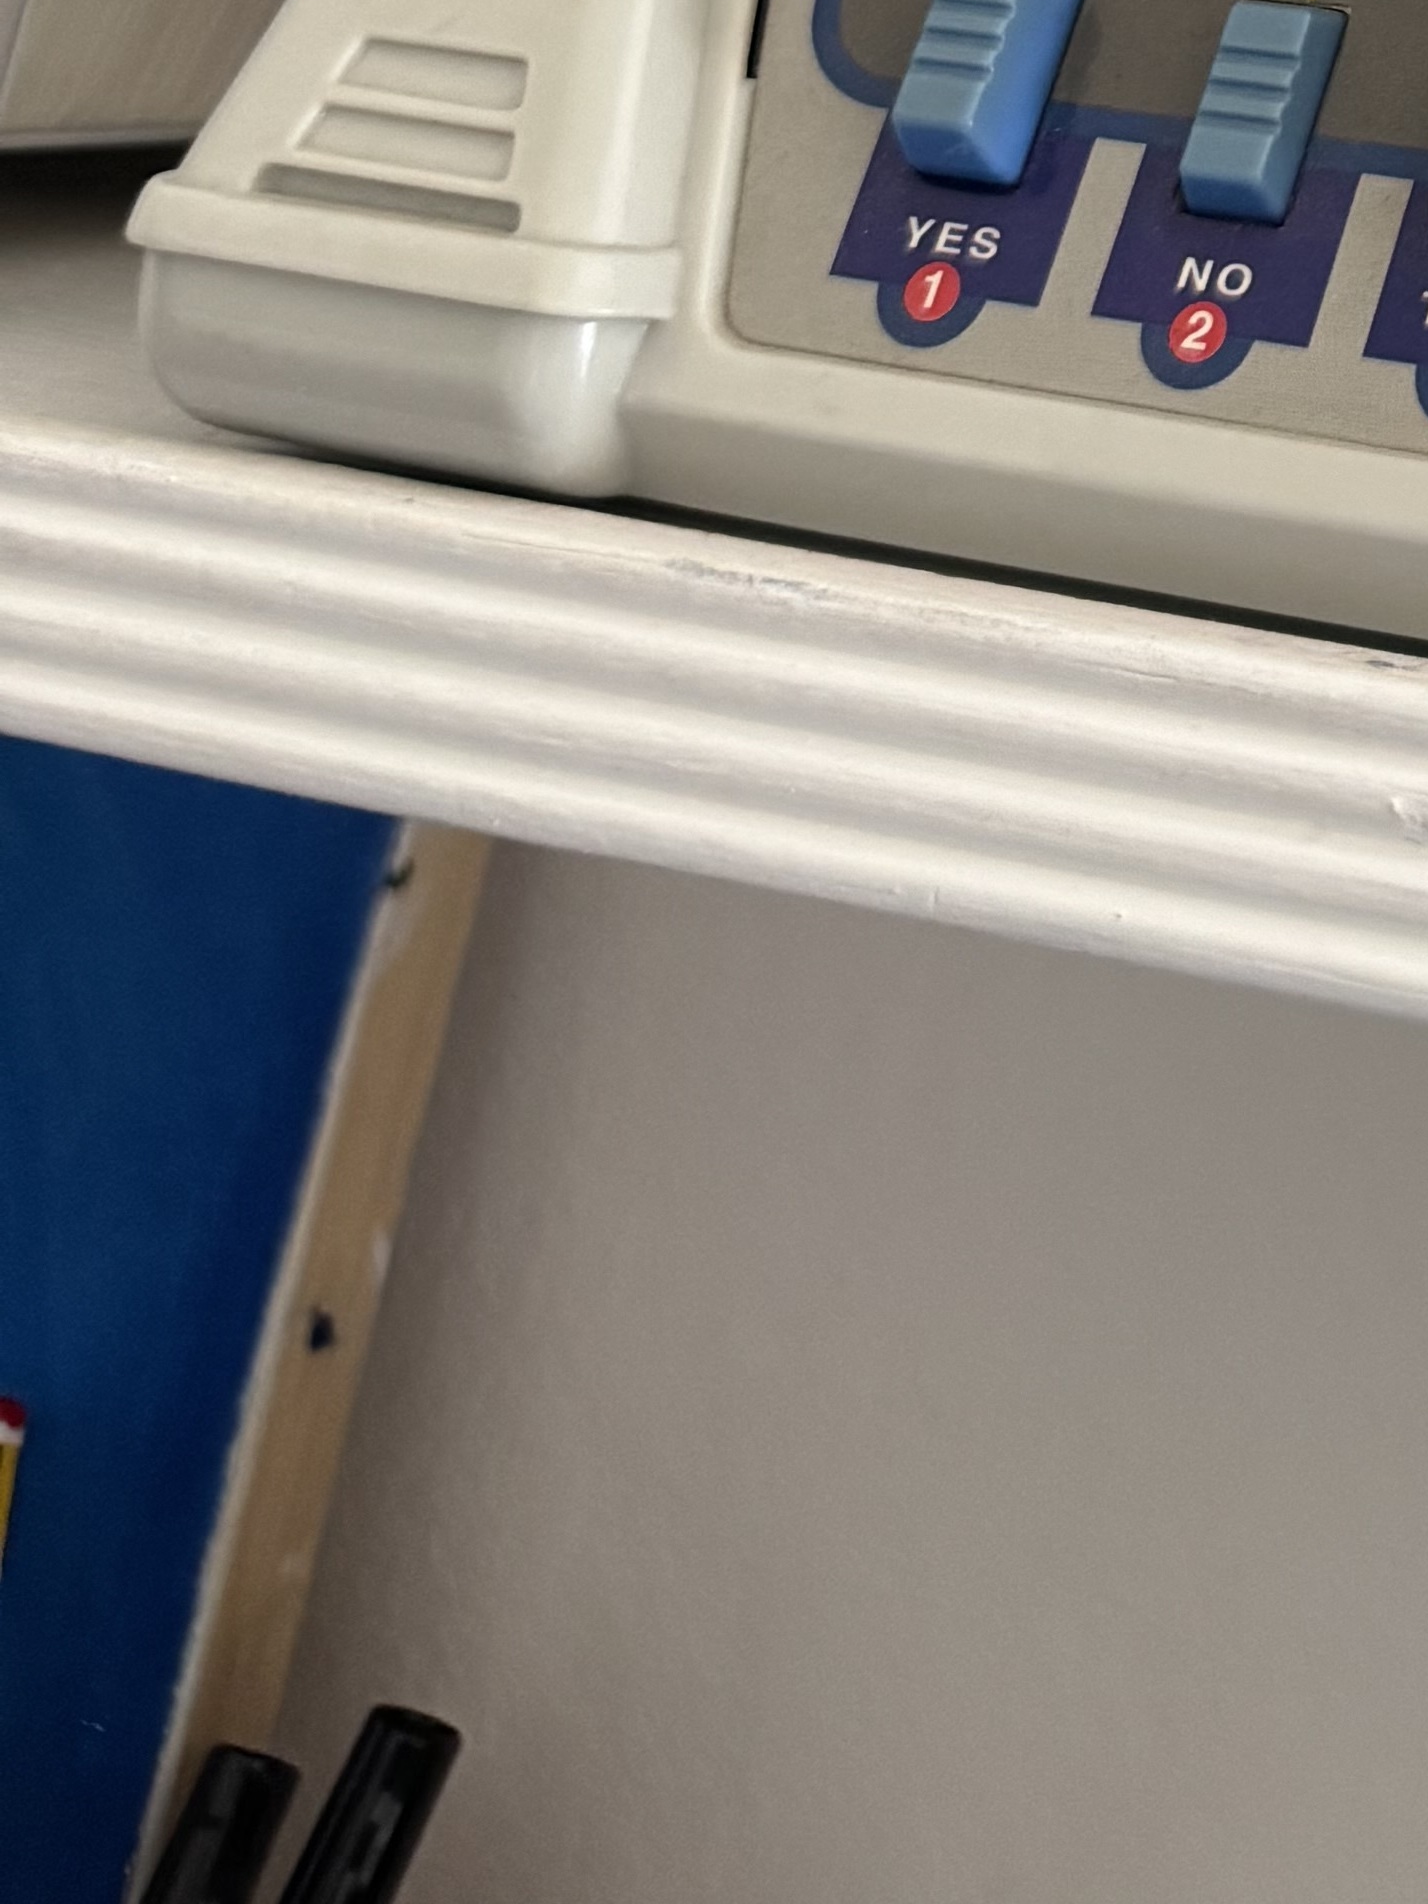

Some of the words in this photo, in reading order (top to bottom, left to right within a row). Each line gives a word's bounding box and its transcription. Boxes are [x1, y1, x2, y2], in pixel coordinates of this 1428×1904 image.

[905, 215, 1001, 260] YES
[922, 269, 944, 310] 1
[1176, 256, 1254, 297] NO
[1180, 310, 1214, 351] 2
